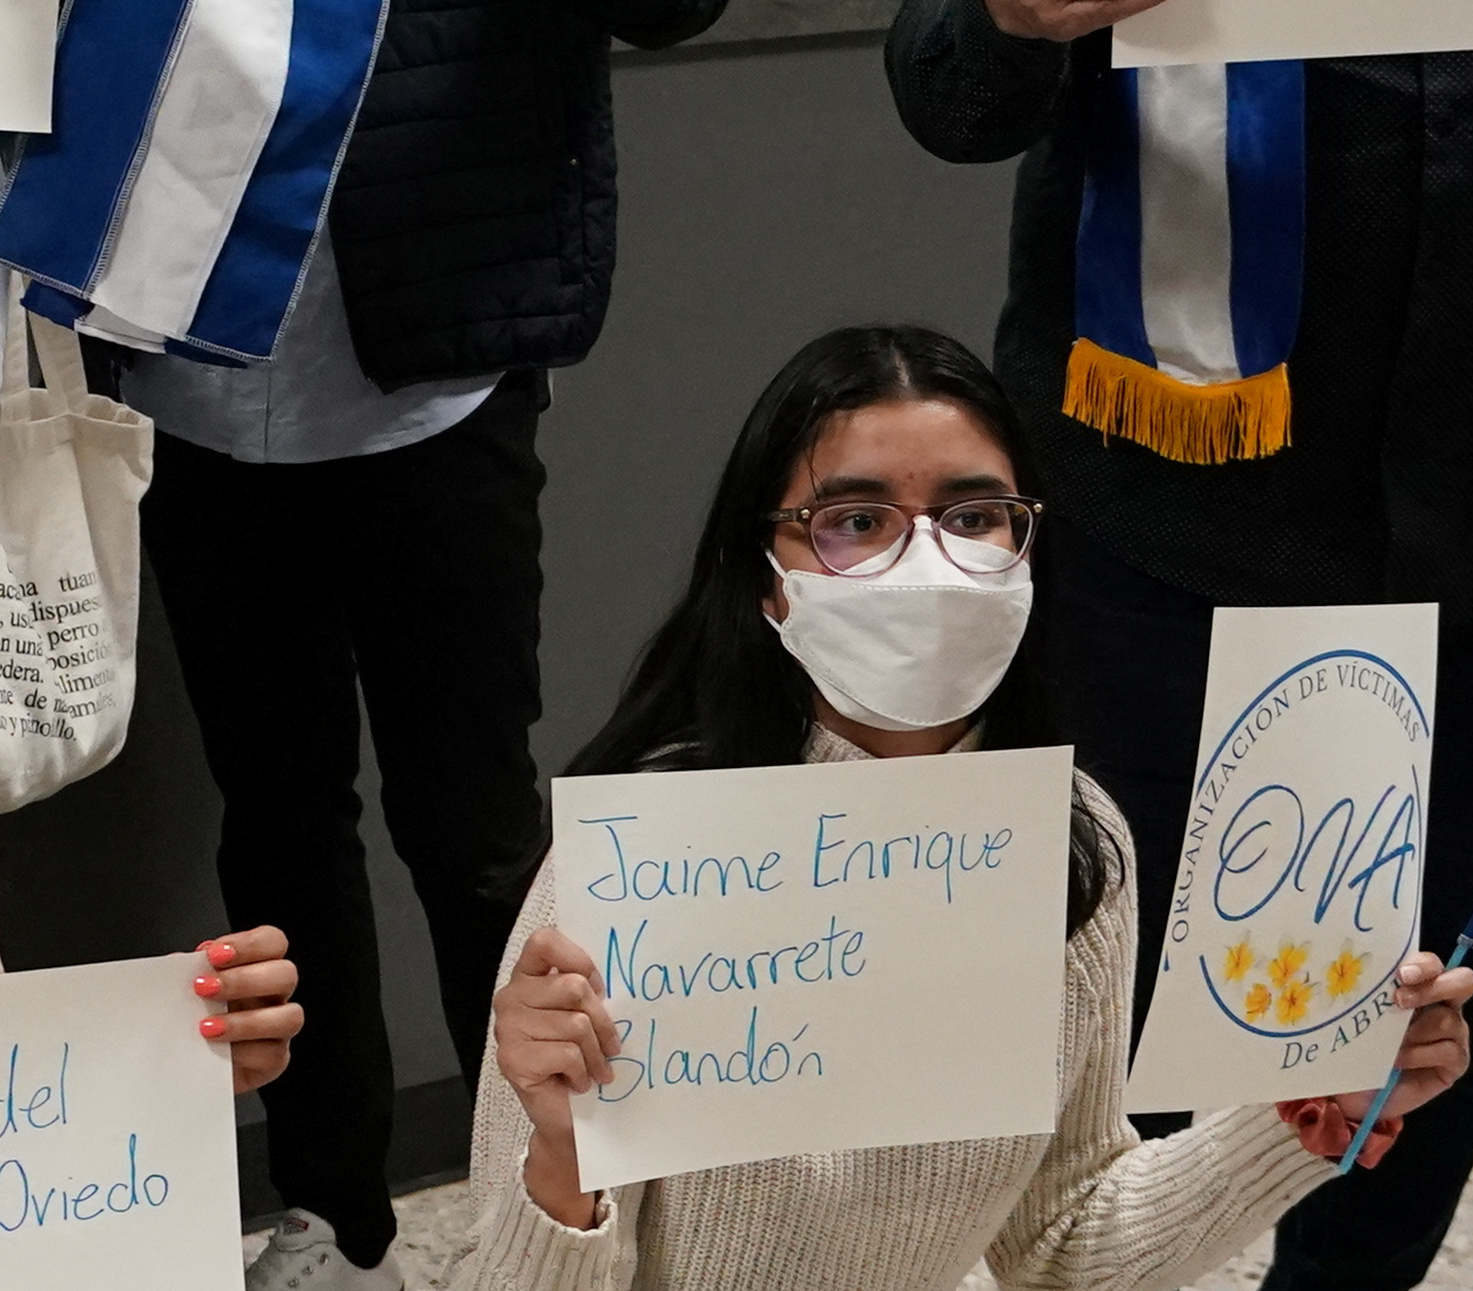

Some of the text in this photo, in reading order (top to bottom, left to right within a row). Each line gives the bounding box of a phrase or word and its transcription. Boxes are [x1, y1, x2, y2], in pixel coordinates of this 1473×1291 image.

[24, 688, 47, 709] de
[1172, 661, 1420, 943] ORGANIZACIÓN DE VÍCTIMAS
[577, 813, 1013, 904] Jaime Enrique
[604, 915, 867, 1002] Navarrete
[1280, 1041, 1319, 1070] De
